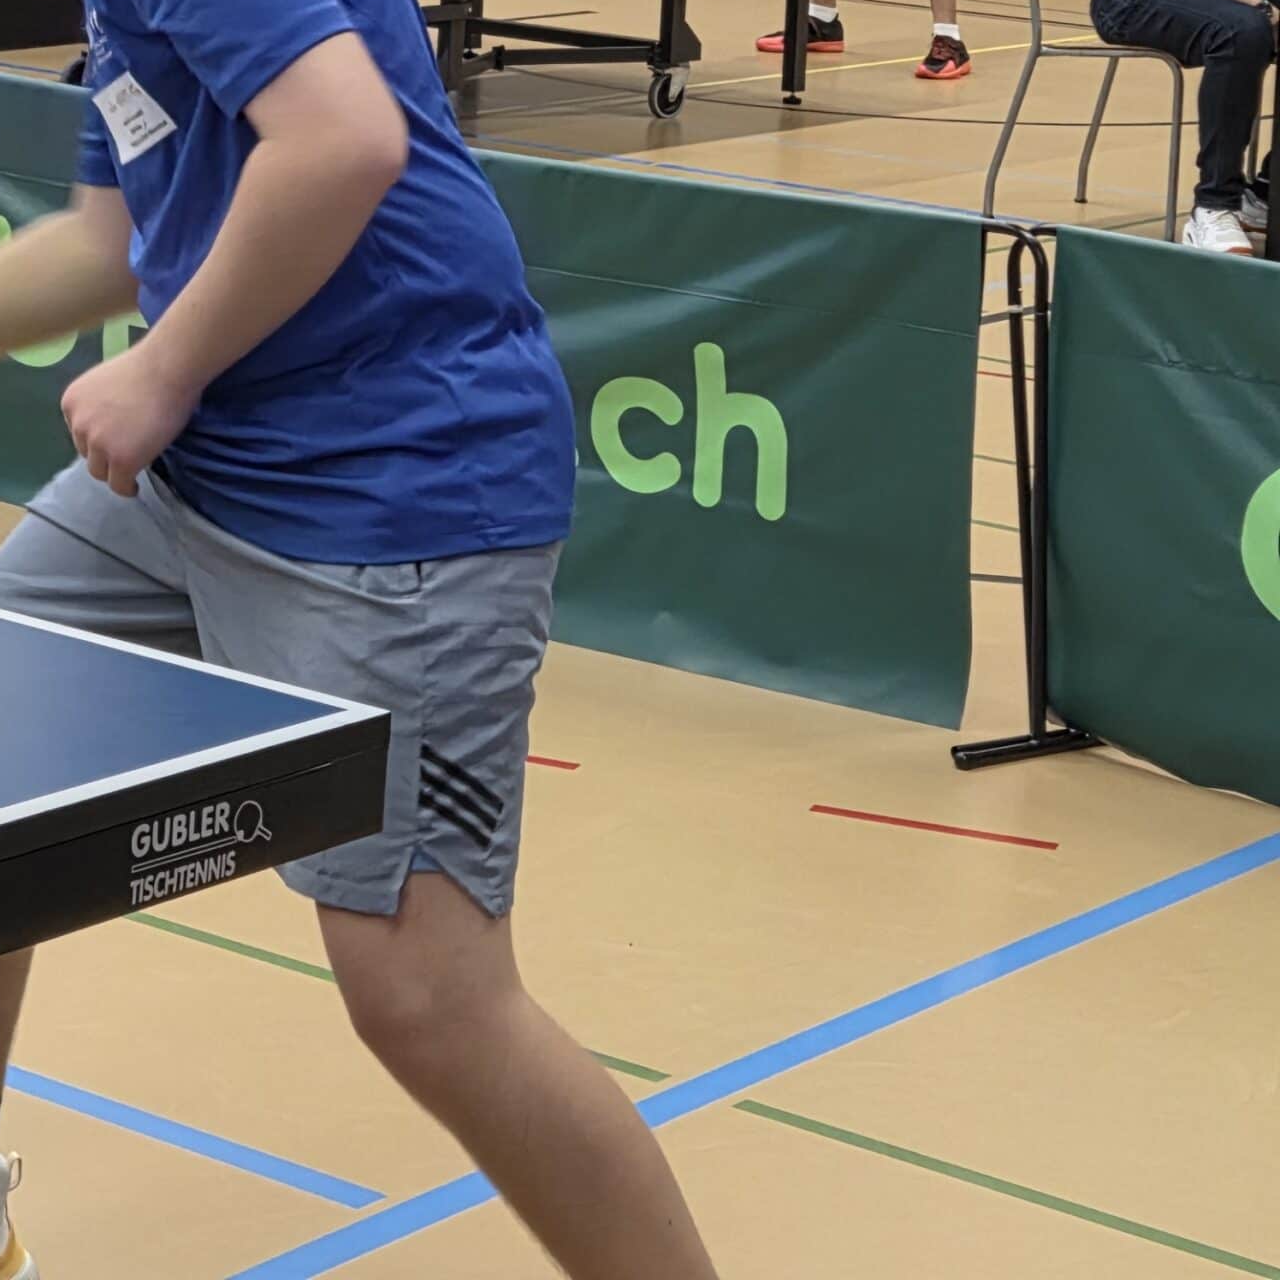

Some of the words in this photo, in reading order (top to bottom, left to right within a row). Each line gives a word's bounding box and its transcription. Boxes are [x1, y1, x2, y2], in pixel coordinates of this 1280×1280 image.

[576, 341, 788, 521] ch
[131, 801, 231, 858] GUBLER
[130, 850, 236, 905] TISCHTENNIS
